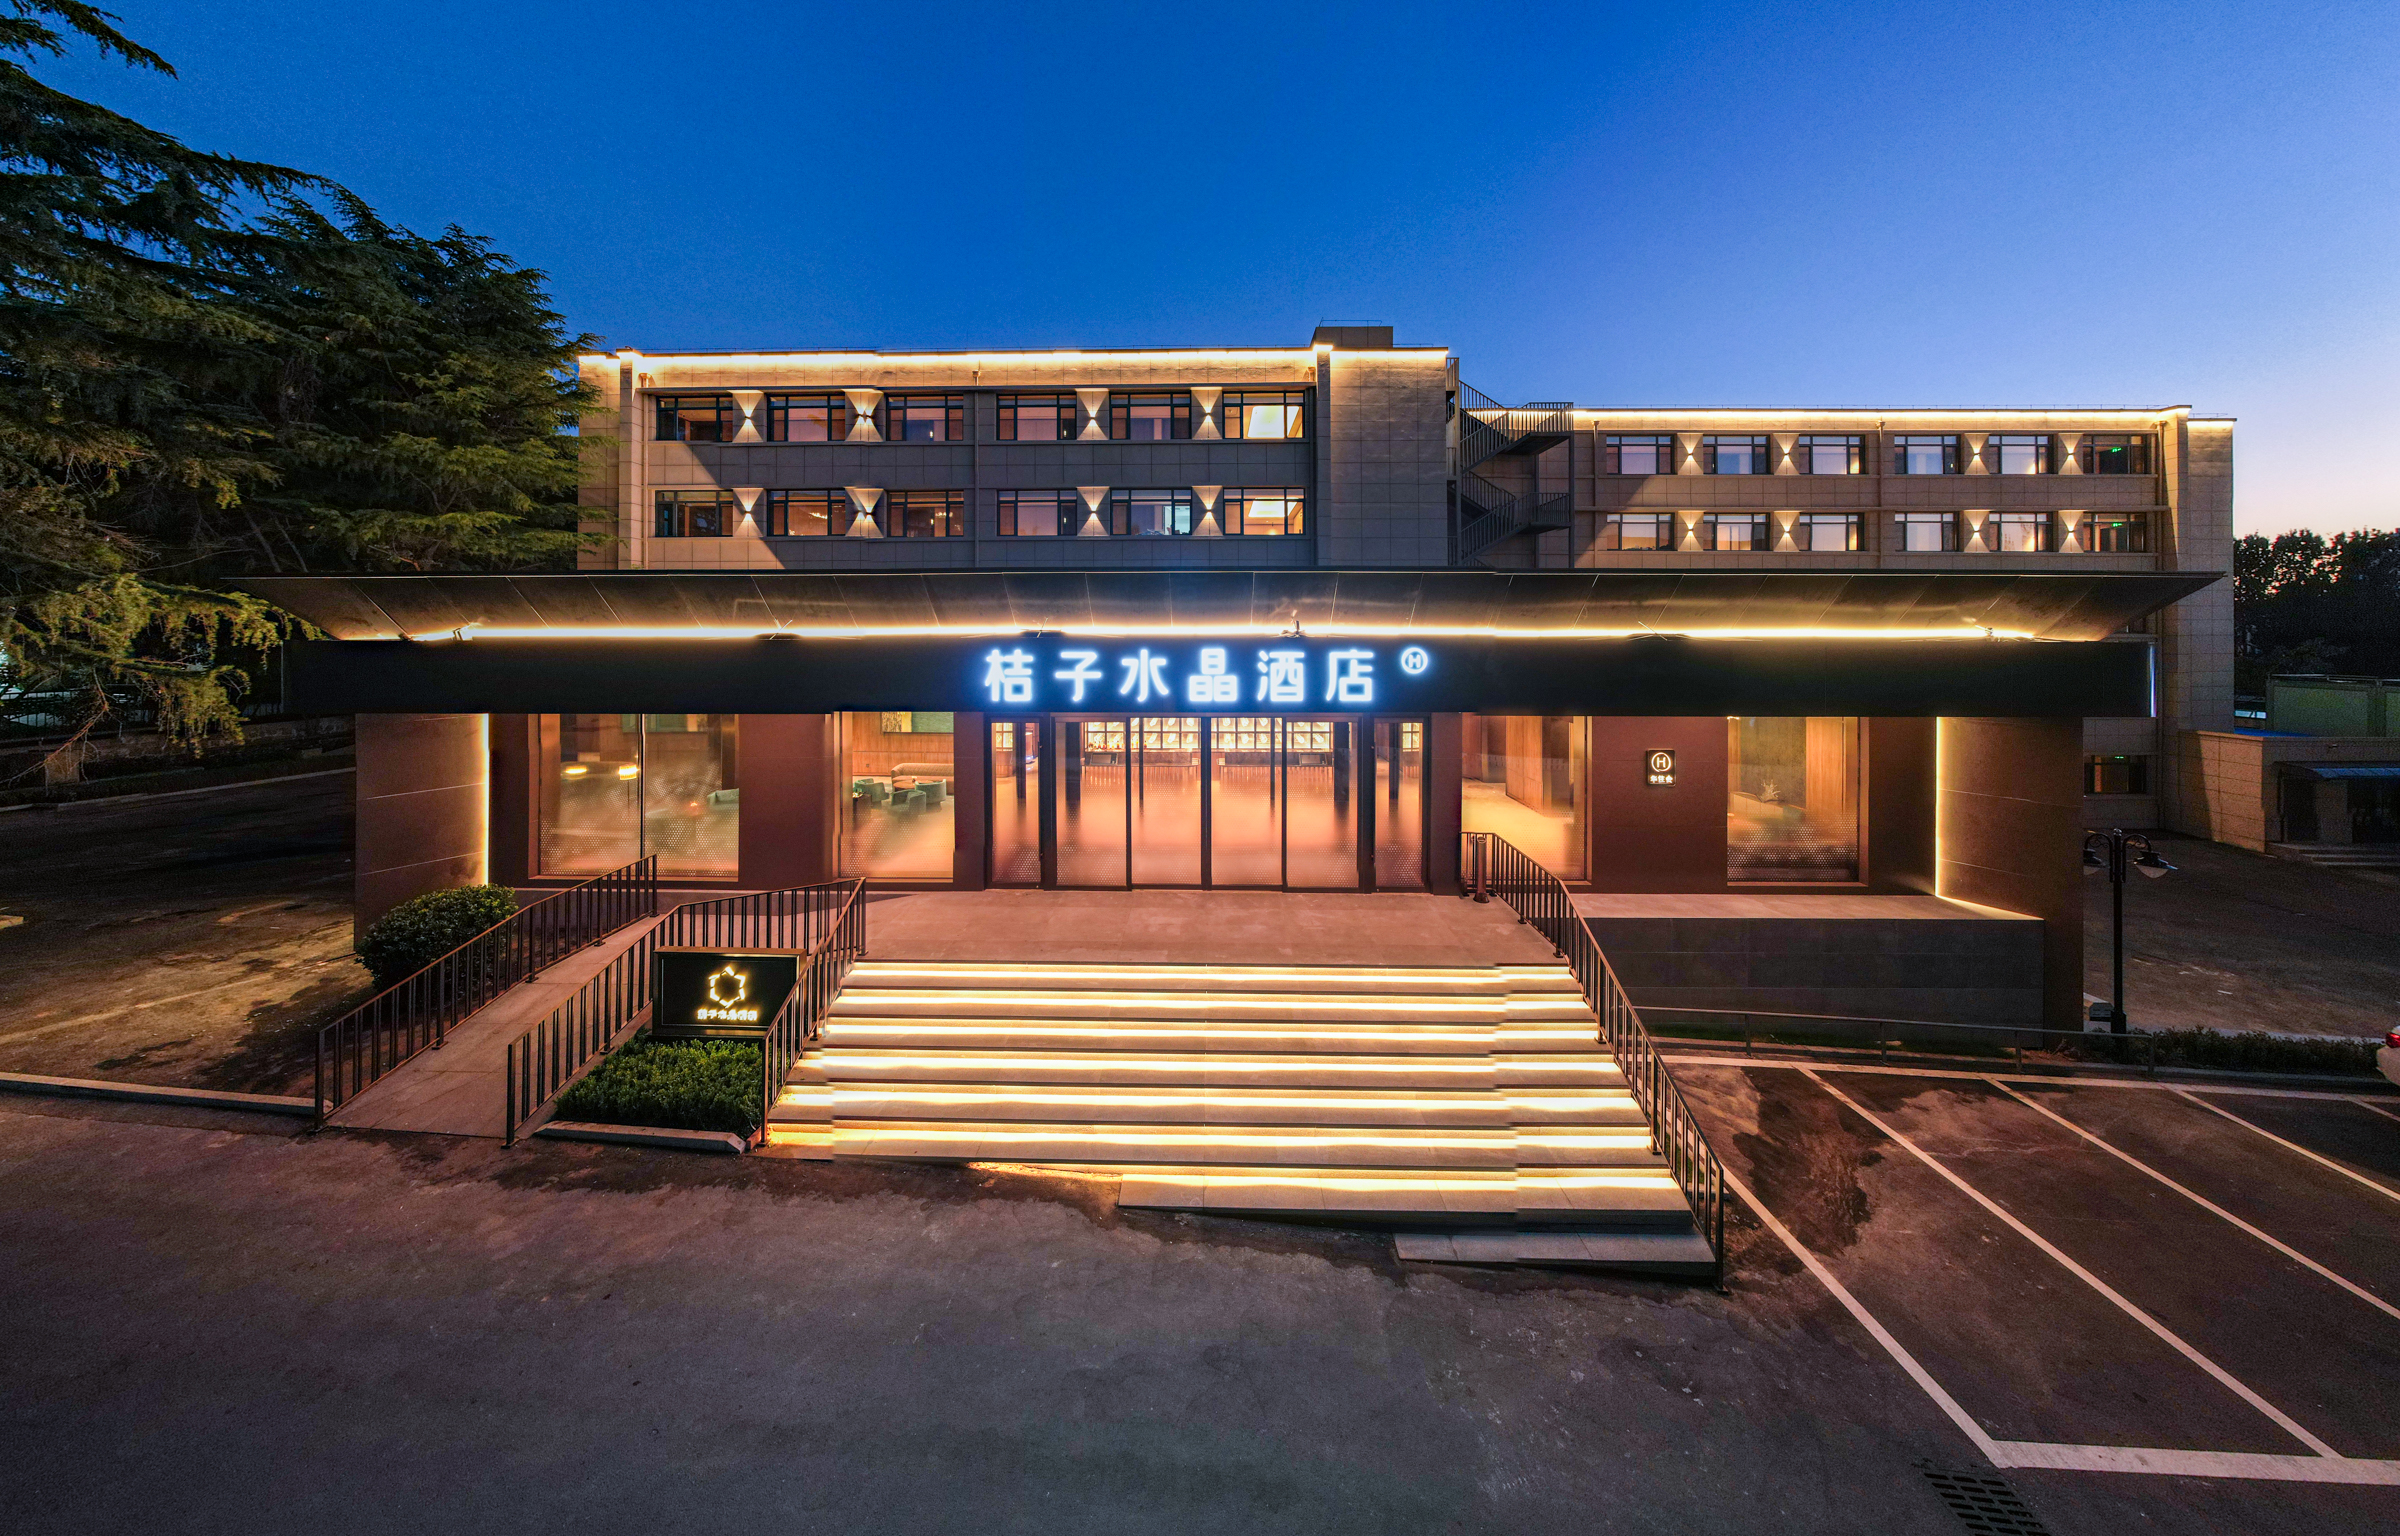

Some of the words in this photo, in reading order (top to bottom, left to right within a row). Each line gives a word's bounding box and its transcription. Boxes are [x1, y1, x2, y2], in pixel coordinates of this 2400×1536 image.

[984, 648, 1374, 702] 桔子水晶酒店
